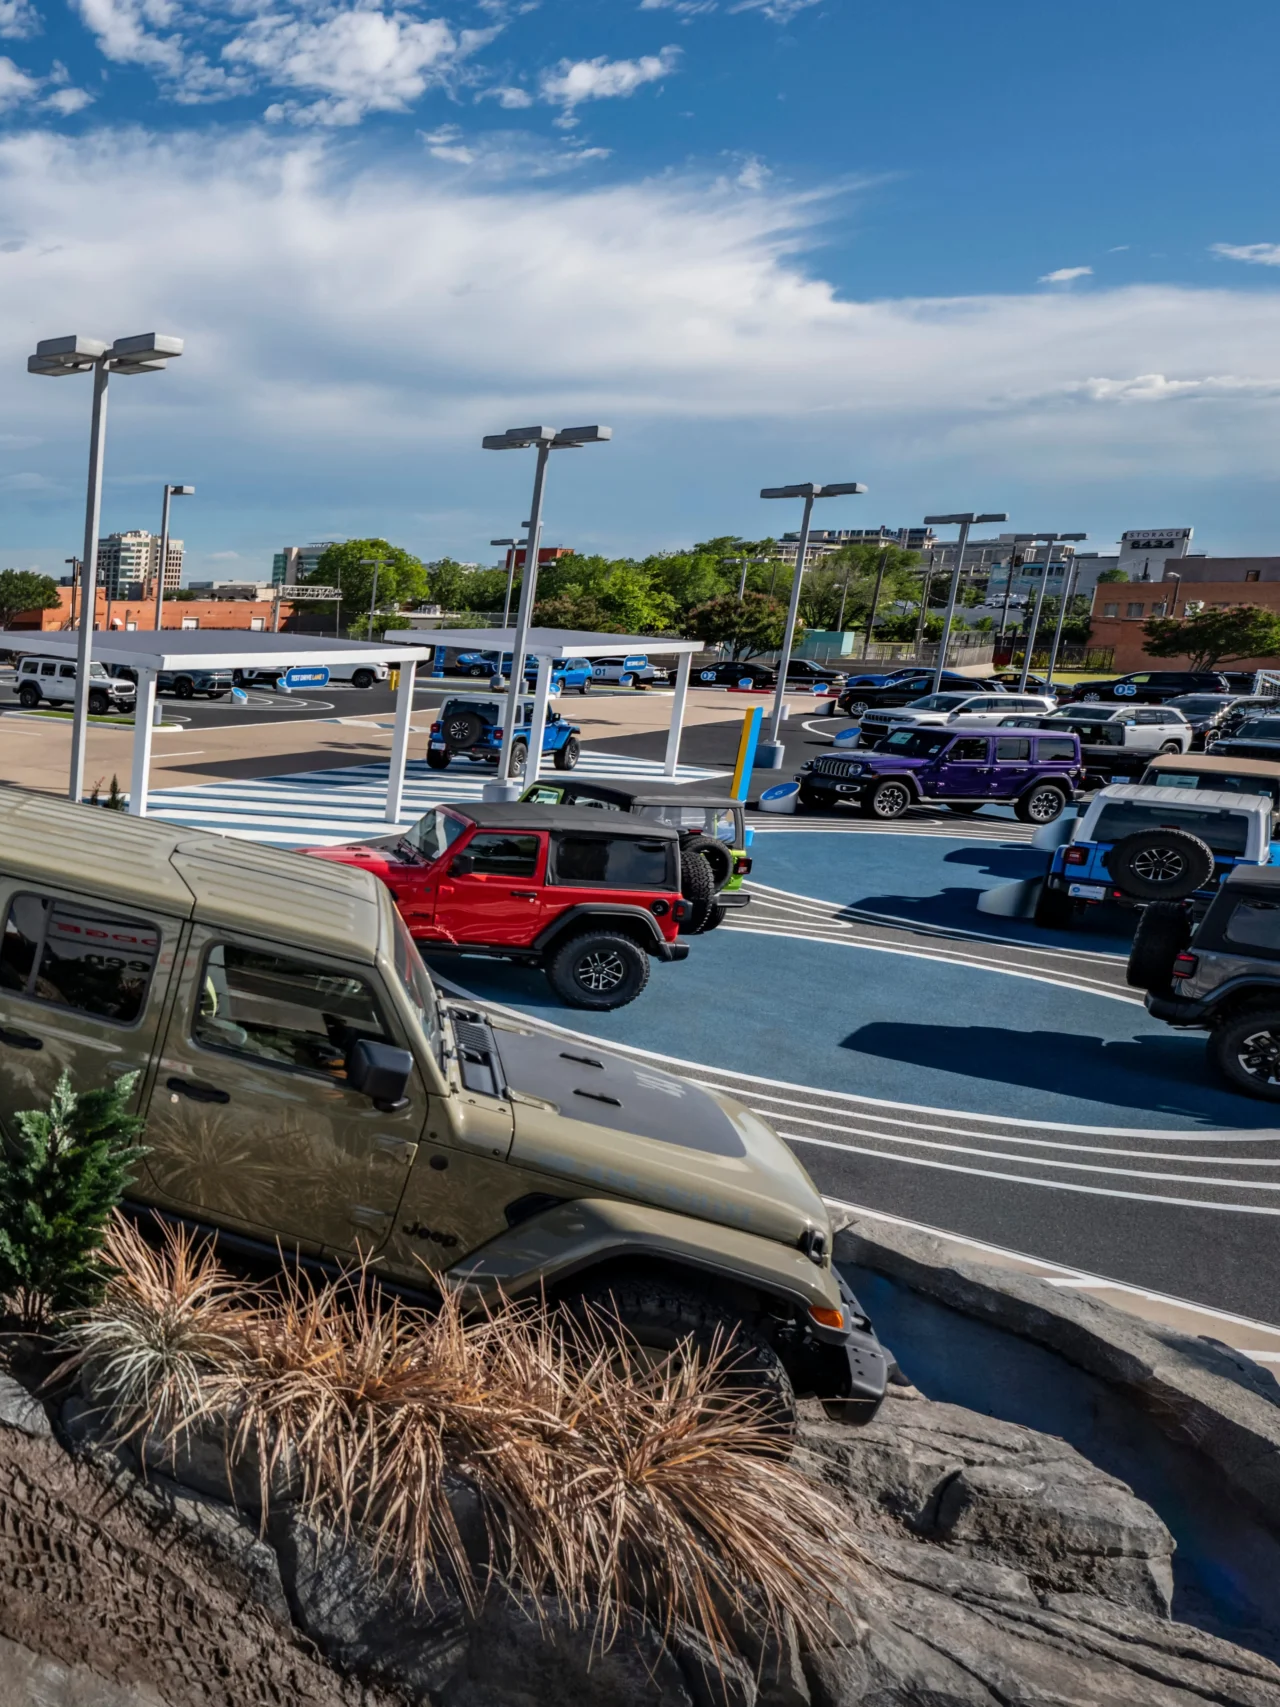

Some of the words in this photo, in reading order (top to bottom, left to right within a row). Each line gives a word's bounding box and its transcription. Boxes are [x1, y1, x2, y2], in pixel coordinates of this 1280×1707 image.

[1130, 540, 1175, 549] 6434
[594, 668, 607, 677] 01
[700, 671, 717, 681] 02
[1114, 684, 1137, 696] 05
[402, 1221, 458, 1248] Jeep
